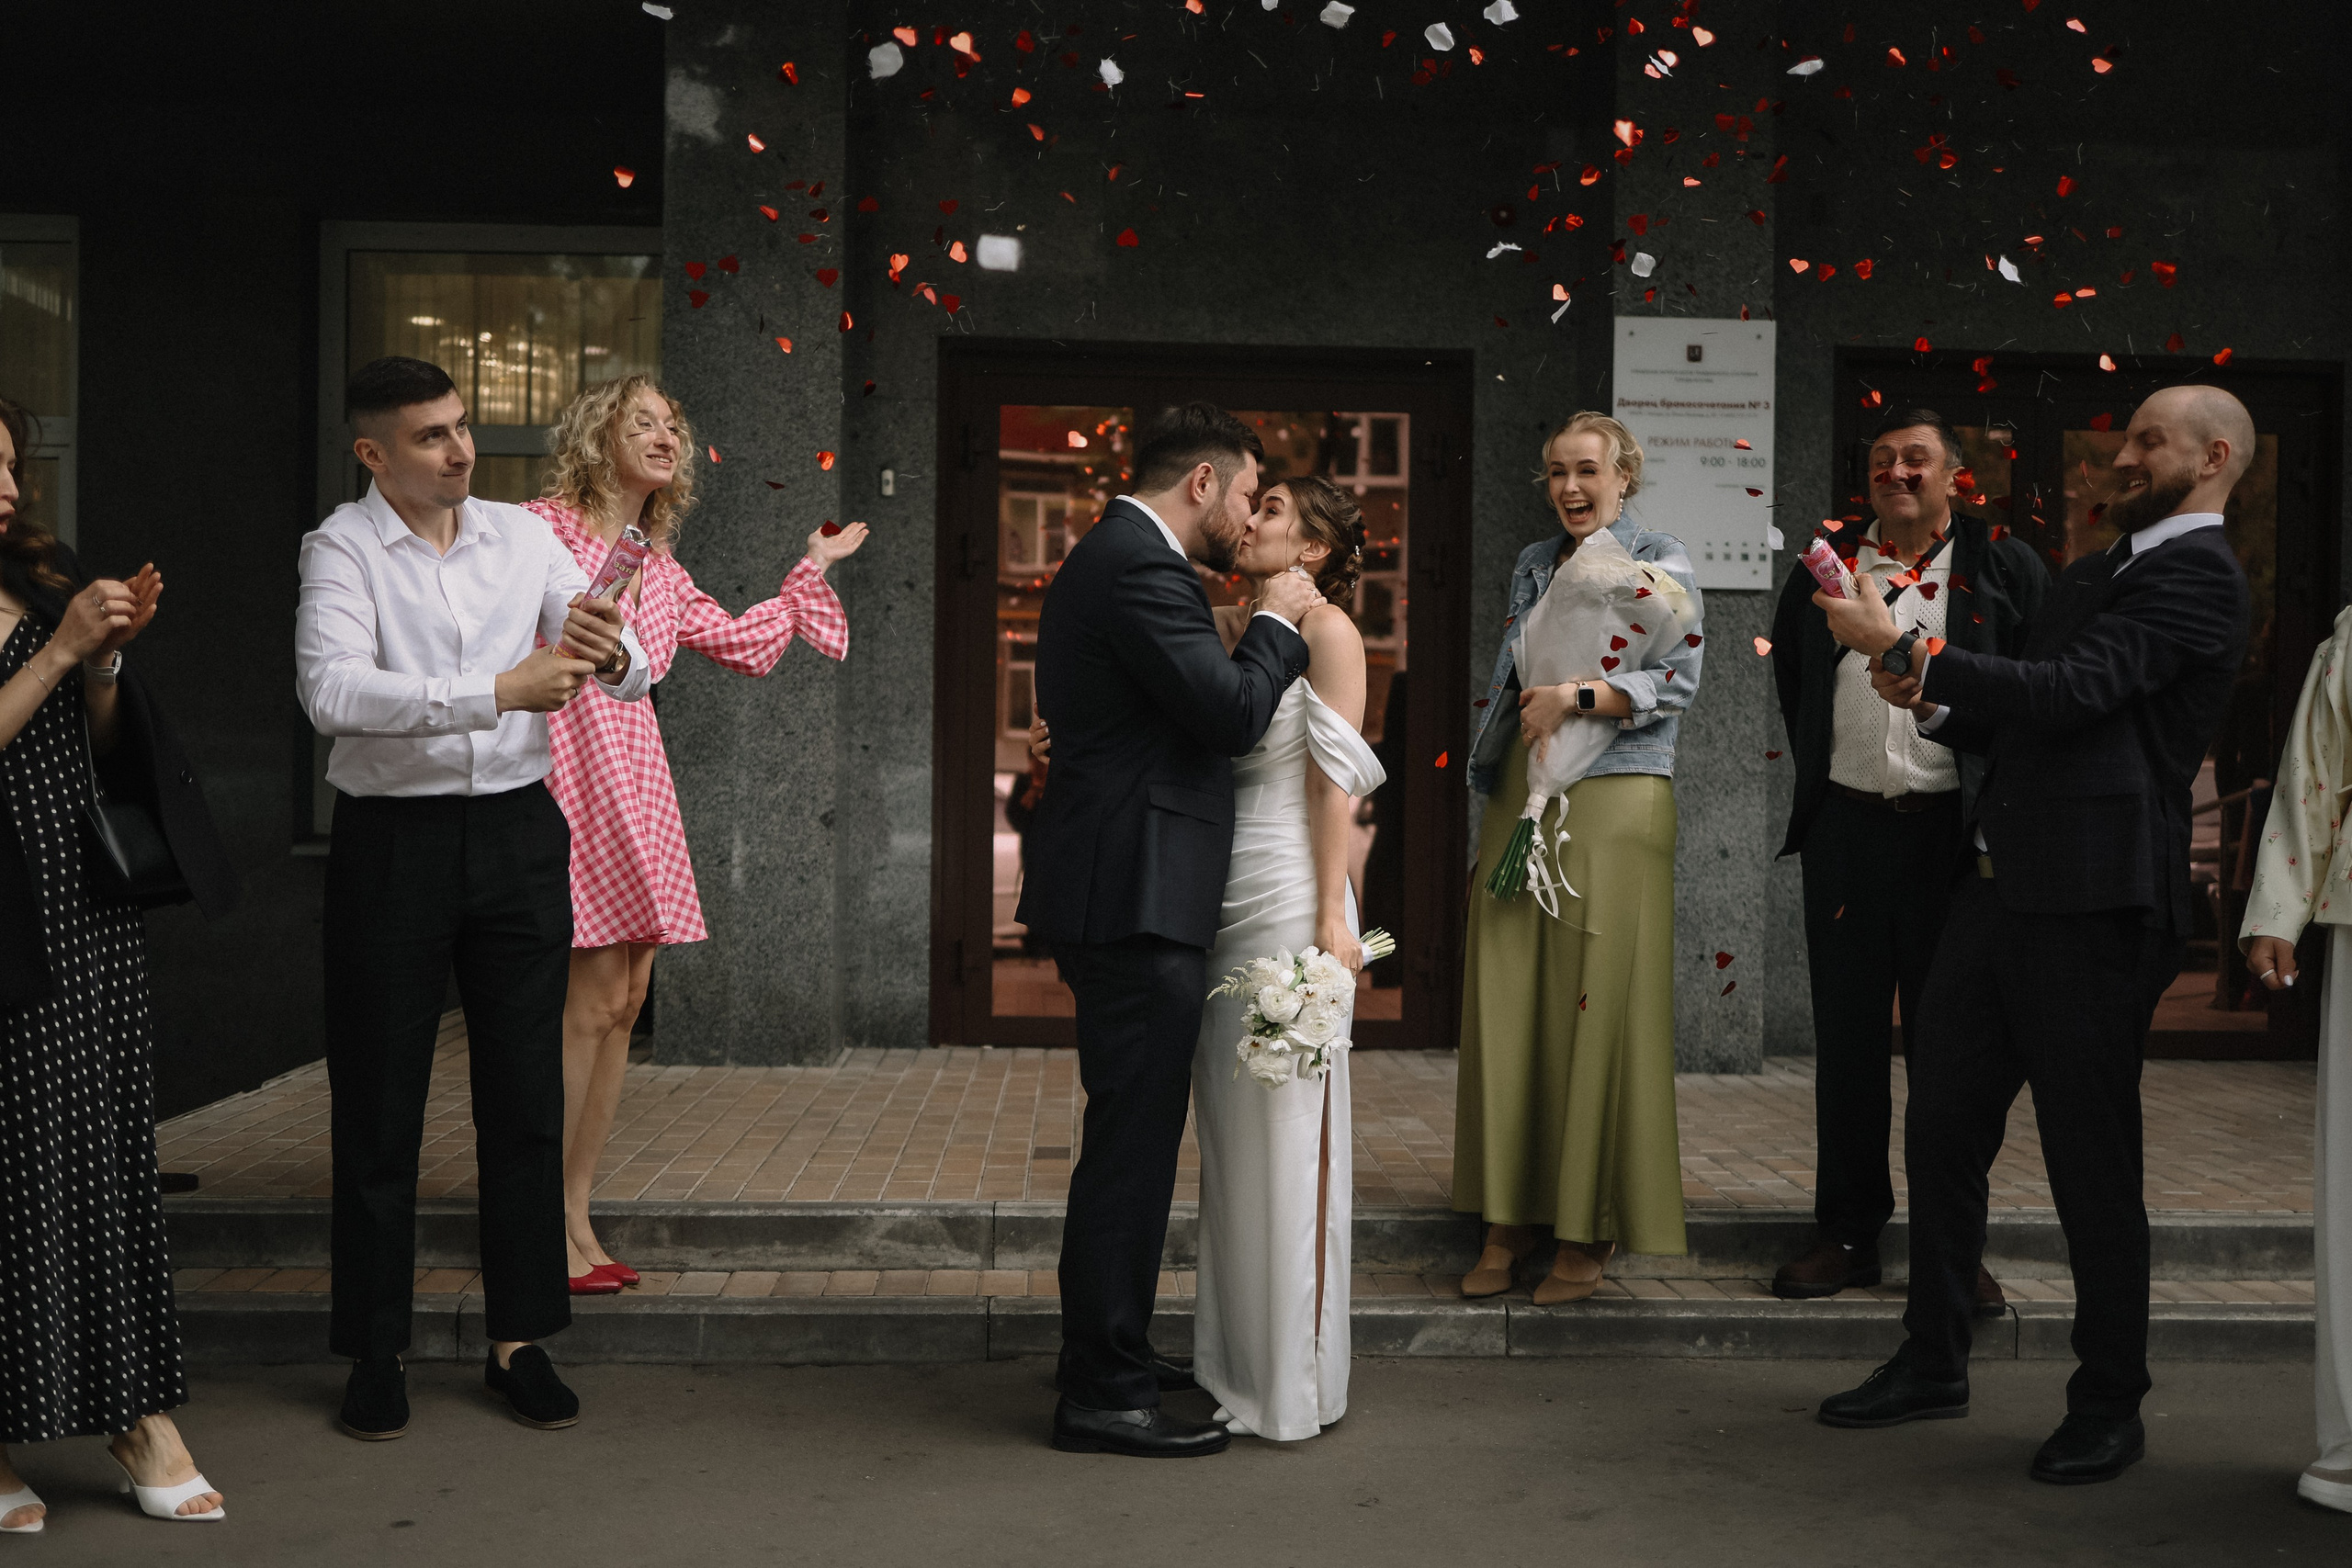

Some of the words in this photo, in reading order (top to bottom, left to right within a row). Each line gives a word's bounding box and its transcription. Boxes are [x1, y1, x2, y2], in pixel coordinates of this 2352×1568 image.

[1617, 397, 1657, 409] Дворец
[1659, 398, 1746, 410] бракосочетания
[1647, 436, 1690, 447] РЕЖИМ
